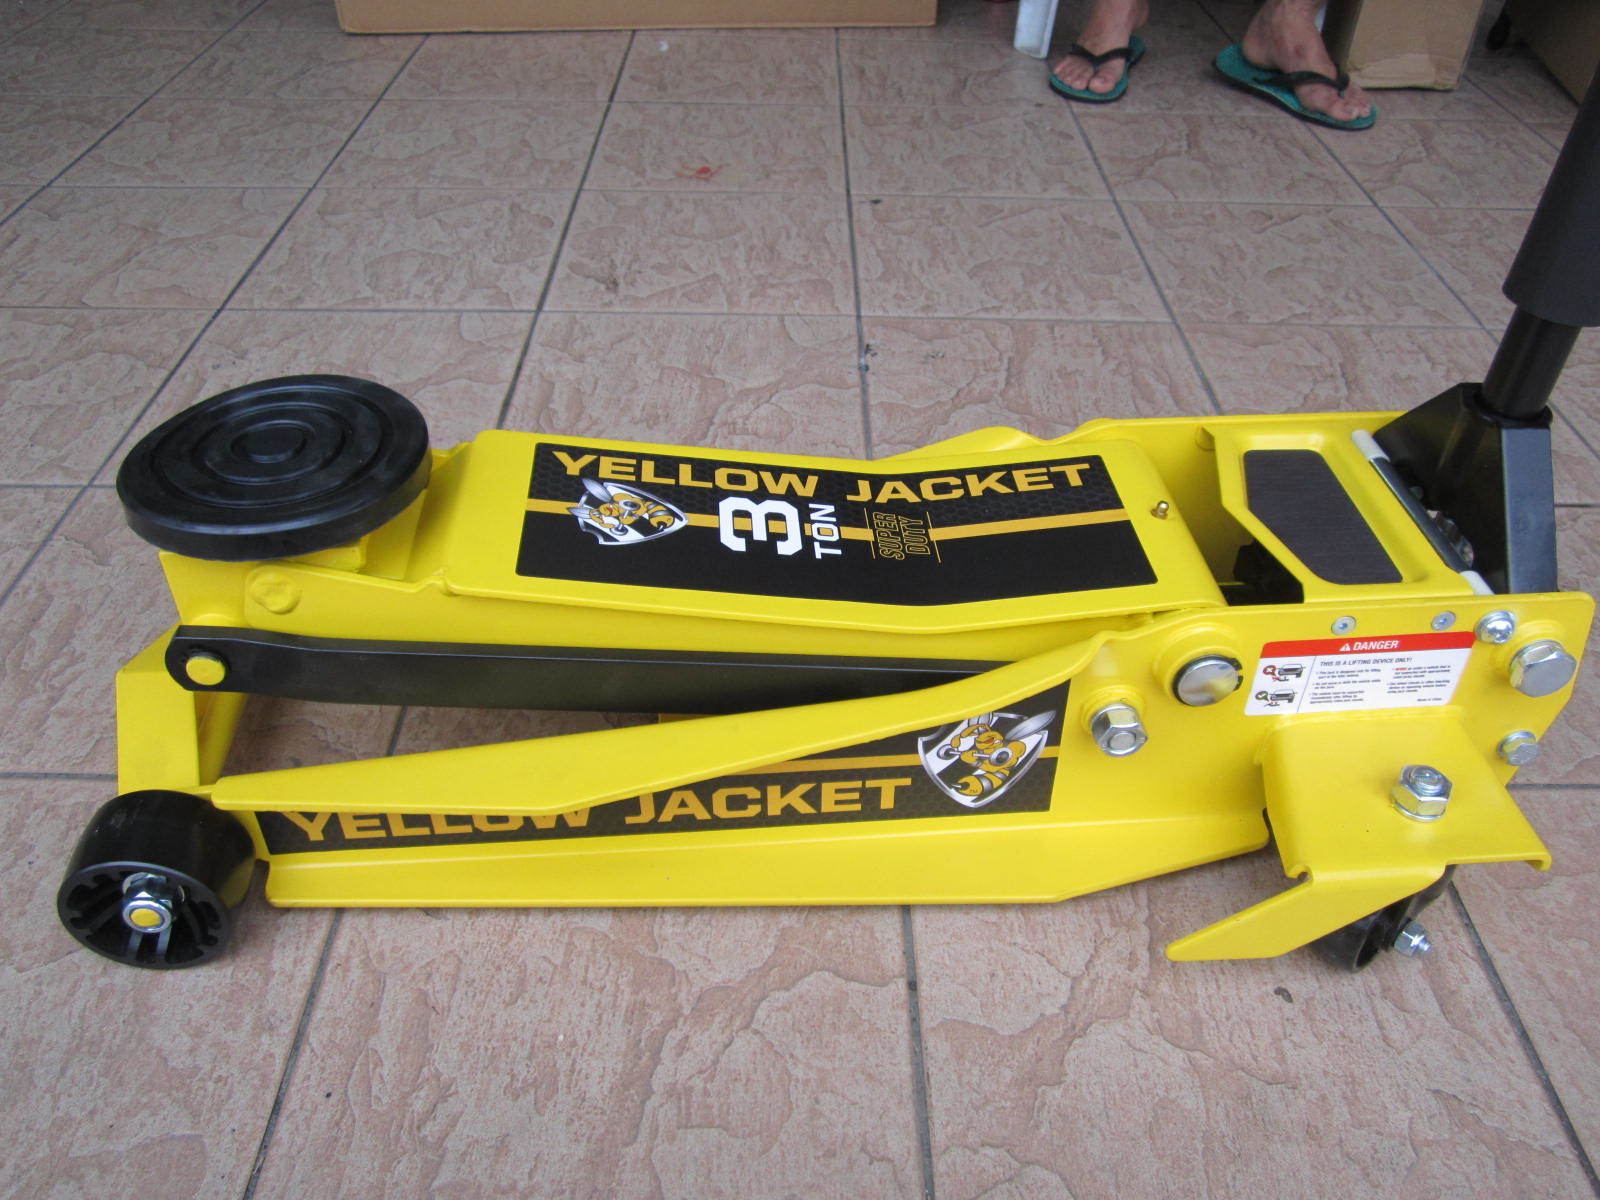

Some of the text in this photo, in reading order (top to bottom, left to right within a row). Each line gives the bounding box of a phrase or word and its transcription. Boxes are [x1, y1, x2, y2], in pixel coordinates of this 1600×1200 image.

[552, 450, 1091, 504] YELLOW JACKET
[718, 496, 803, 556] 3
[808, 503, 842, 559] TON
[872, 511, 906, 561] SUPER
[899, 515, 931, 555] DUTY
[1353, 640, 1399, 651] DANGER
[624, 777, 912, 824] JACKET
